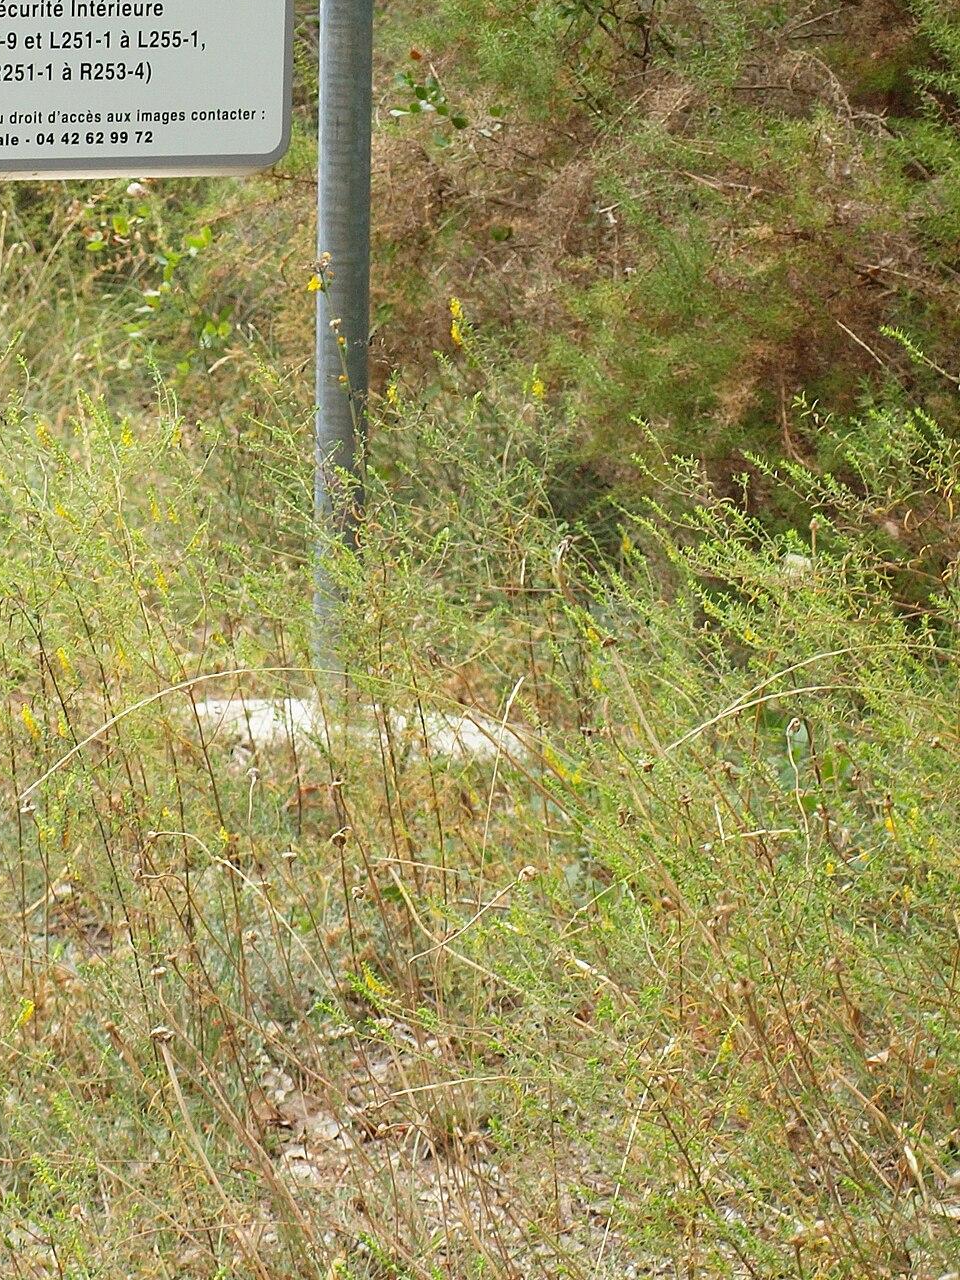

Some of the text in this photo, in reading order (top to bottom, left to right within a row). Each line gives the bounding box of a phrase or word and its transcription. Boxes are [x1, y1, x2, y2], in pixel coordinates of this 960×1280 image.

[24, 32, 42, 50] et
[50, 30, 111, 49] L251-1
[120, 29, 130, 49] à
[138, 30, 206, 52] L255-1,
[61, 62, 72, 81] à
[80, 61, 152, 85] R253-4)
[9, 110, 43, 125] droit
[106, 112, 131, 123] aux
[136, 109, 186, 125] images
[190, 108, 257, 122] contacter
[36, 132, 55, 146] 04
[60, 132, 80, 145] 42
[85, 131, 105, 145] 62
[110, 131, 129, 144] 99
[134, 130, 153, 144] 72
